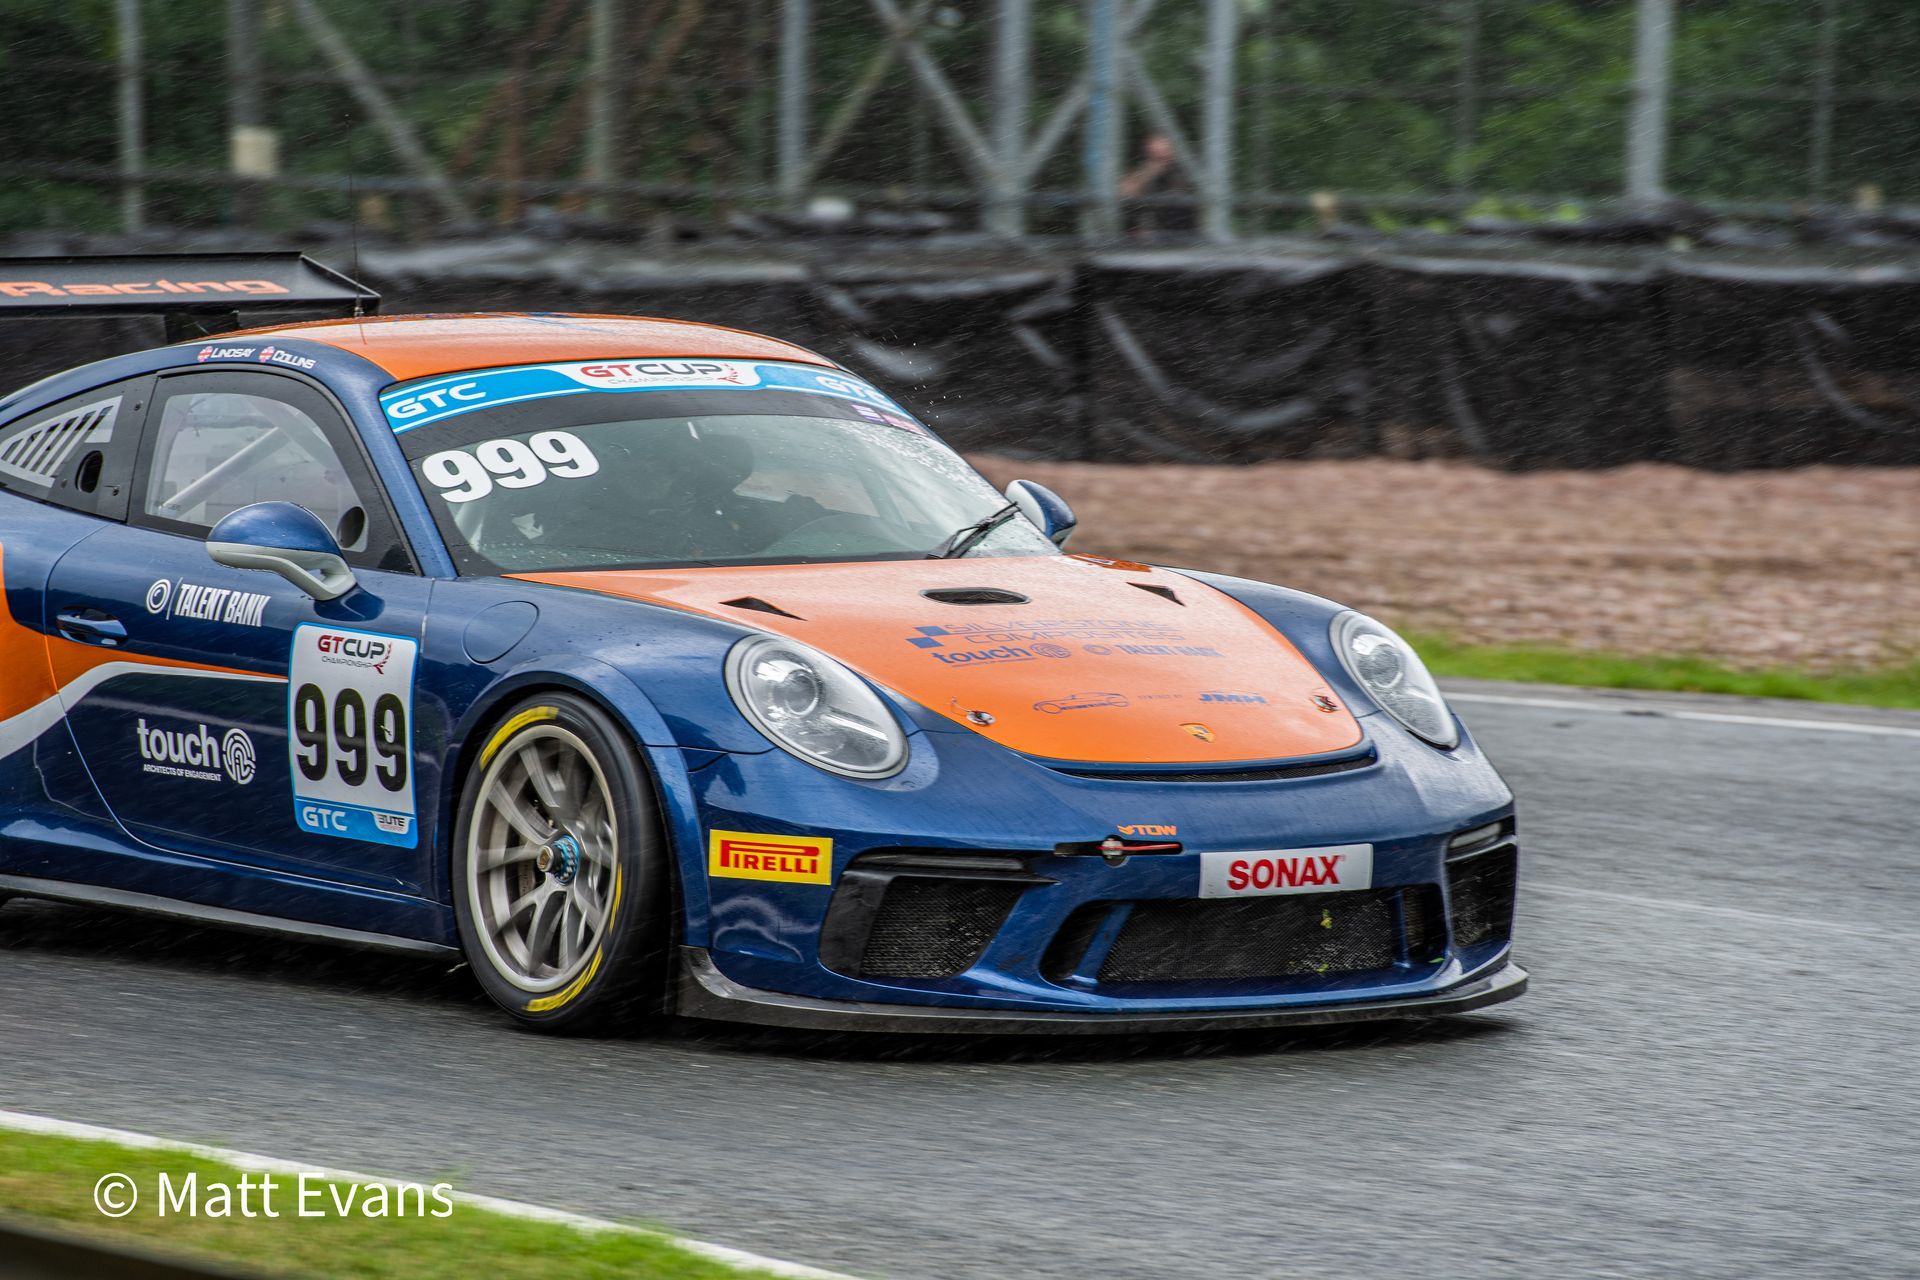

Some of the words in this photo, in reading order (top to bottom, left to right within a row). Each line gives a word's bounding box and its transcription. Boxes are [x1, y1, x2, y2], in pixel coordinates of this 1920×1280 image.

[0, 279, 290, 298] Racing
[210, 347, 257, 359] LINDSAY
[271, 350, 317, 369] COLLINS
[387, 382, 487, 419] GTC
[422, 431, 600, 503] 999
[175, 583, 231, 621] TALENT
[223, 591, 271, 627] BANK
[944, 619, 1169, 632] SILVERSTONE
[964, 630, 1186, 644] COMPOSITES
[321, 655, 375, 669] CHAMPIONSHIP
[931, 645, 1033, 663] touch
[137, 718, 221, 769] touch
[294, 682, 407, 793] 999
[143, 764, 177, 776] ARCHITECTS
[176, 768, 185, 777] OF
[184, 768, 222, 782] ENGAGEMENT
[302, 805, 348, 832] GTC
[1133, 824, 1177, 835] TOW
[720, 839, 820, 875] PIRELLI
[1227, 854, 1341, 891] SONAX
